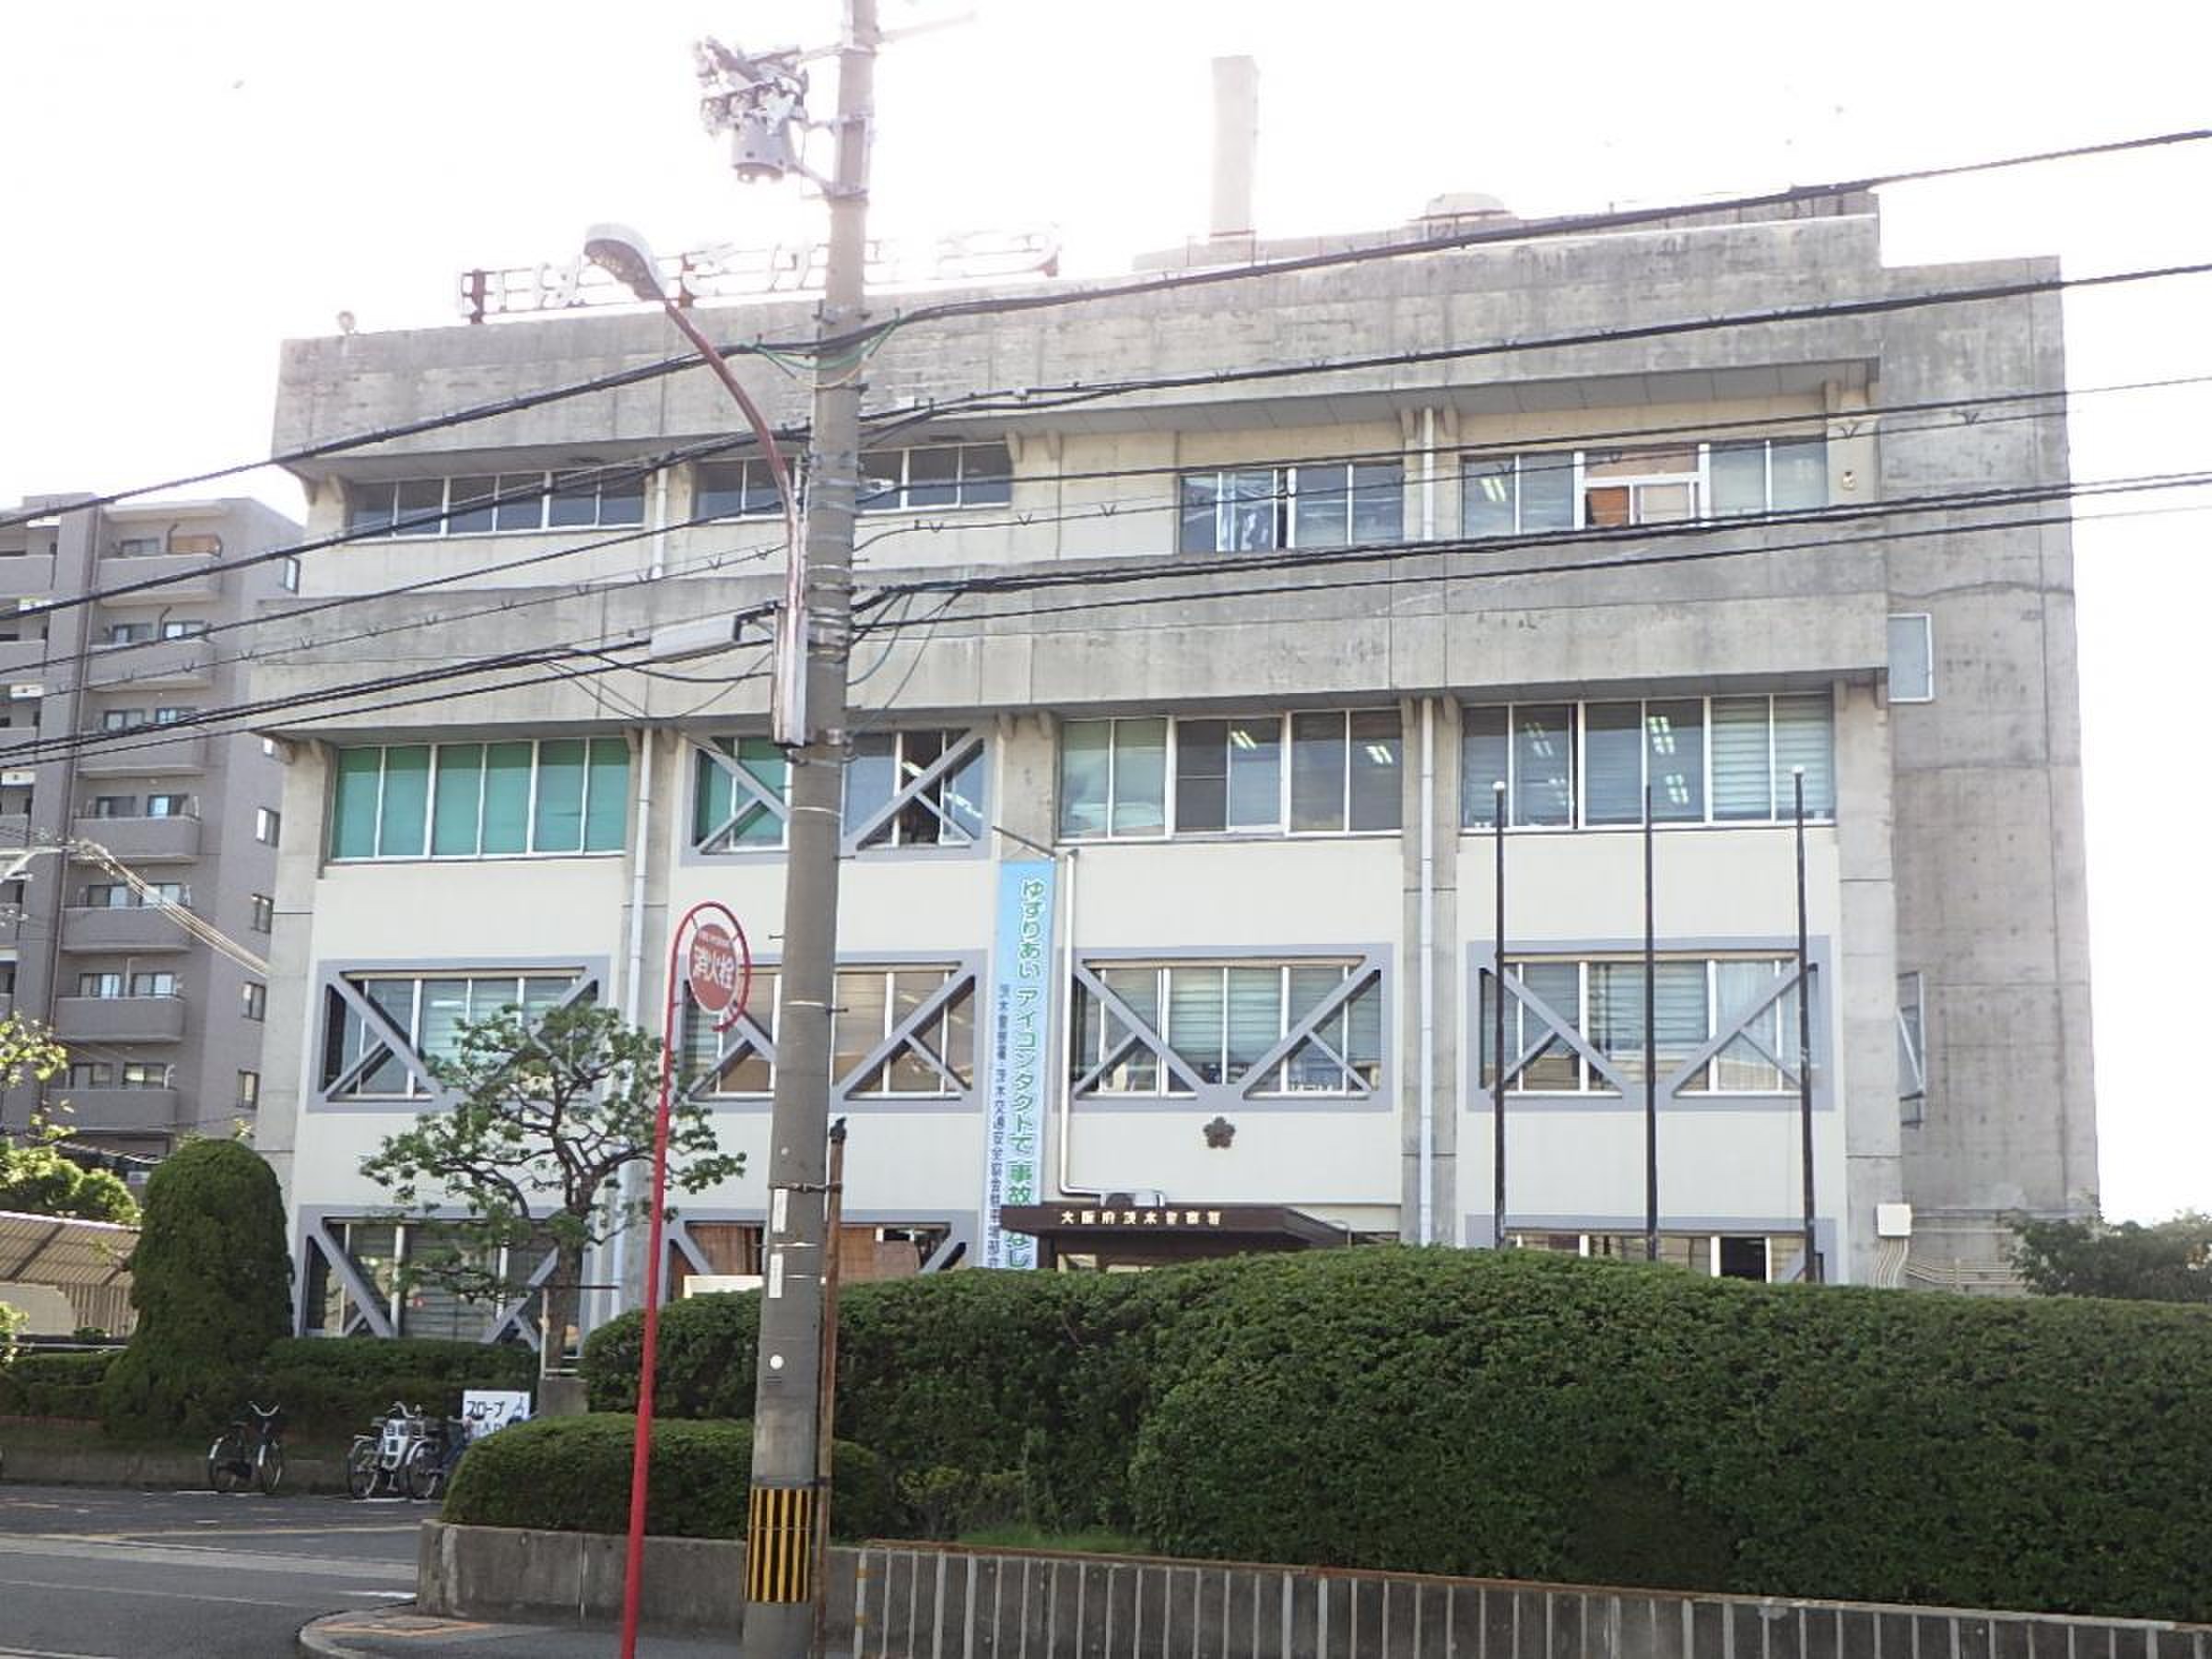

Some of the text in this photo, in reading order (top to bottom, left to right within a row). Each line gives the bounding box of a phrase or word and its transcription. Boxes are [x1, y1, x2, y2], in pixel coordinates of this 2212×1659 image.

[1018, 879, 1045, 979] ゆずりあい
[693, 946, 735, 987] 消火栓
[1009, 988, 1039, 1155] アイコンタクトで
[1061, 1210, 1221, 1225] 大阪府茨木警察署
